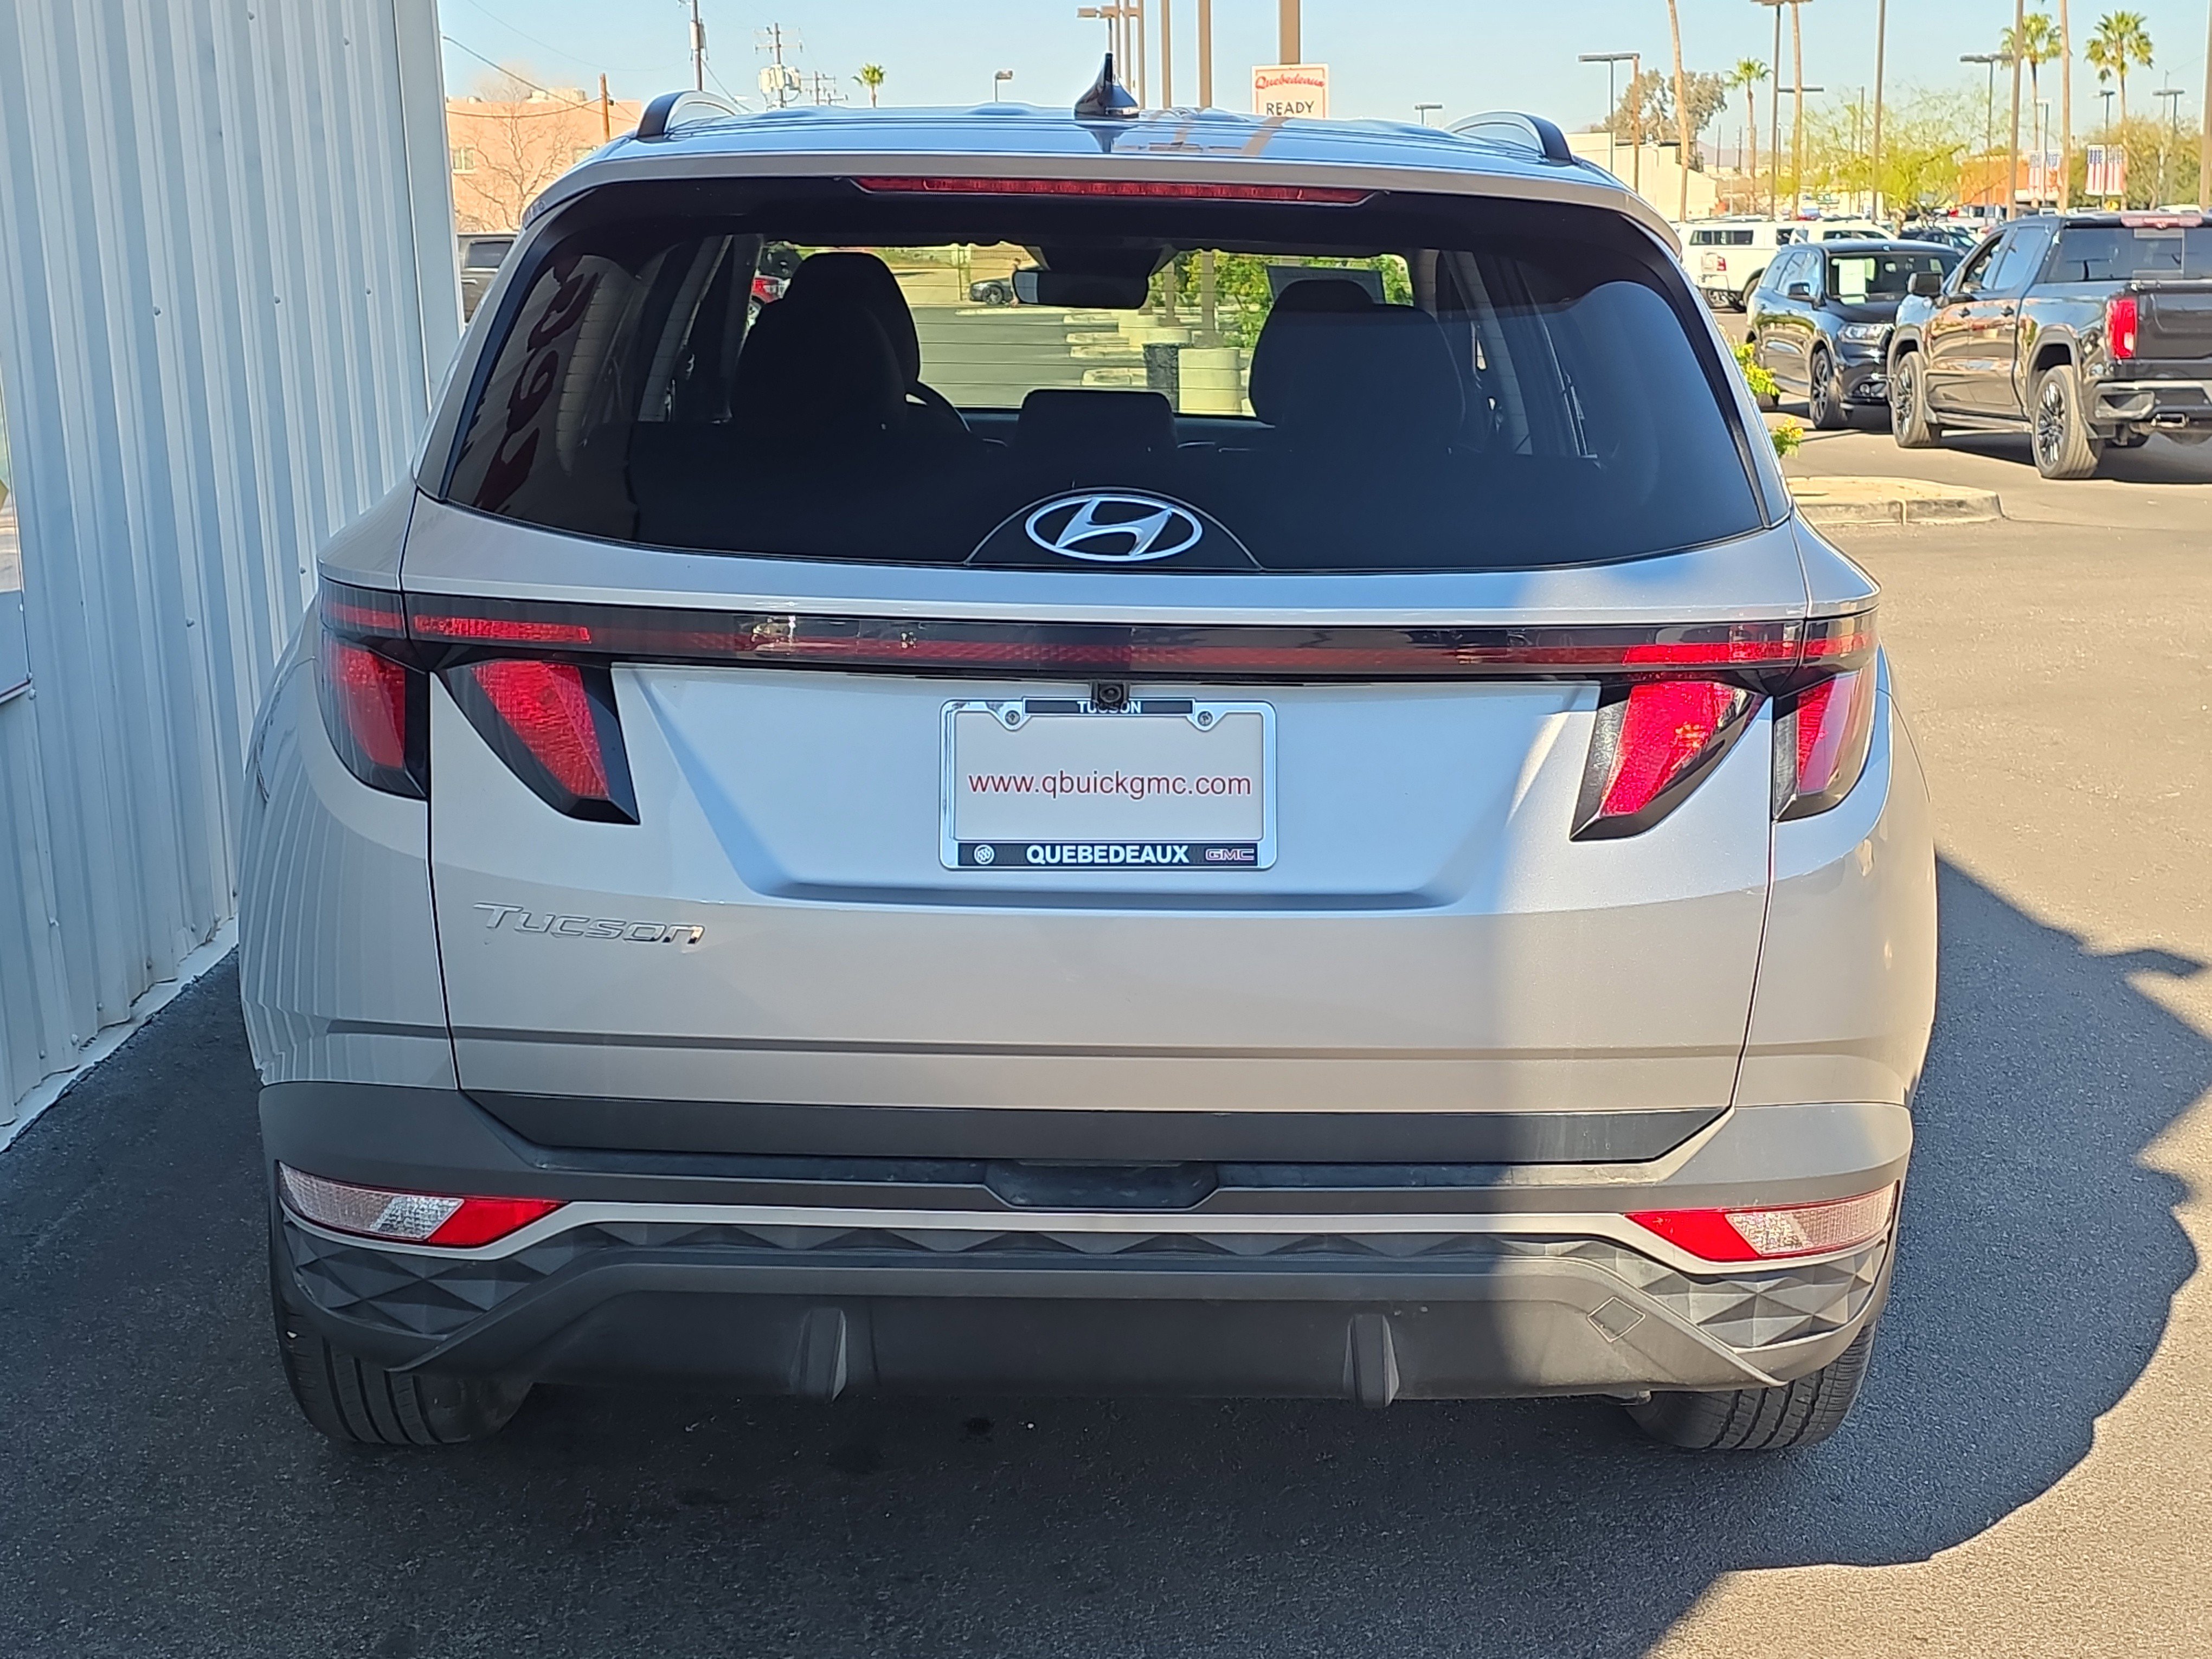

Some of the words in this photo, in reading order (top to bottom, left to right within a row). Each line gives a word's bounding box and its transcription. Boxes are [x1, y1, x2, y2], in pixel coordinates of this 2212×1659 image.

[1266, 100, 1315, 115] READY
[969, 770, 1251, 799] www.qbuickgmc.com
[1026, 845, 1189, 864] QUEBEDEAUX
[1205, 848, 1255, 861] GMC
